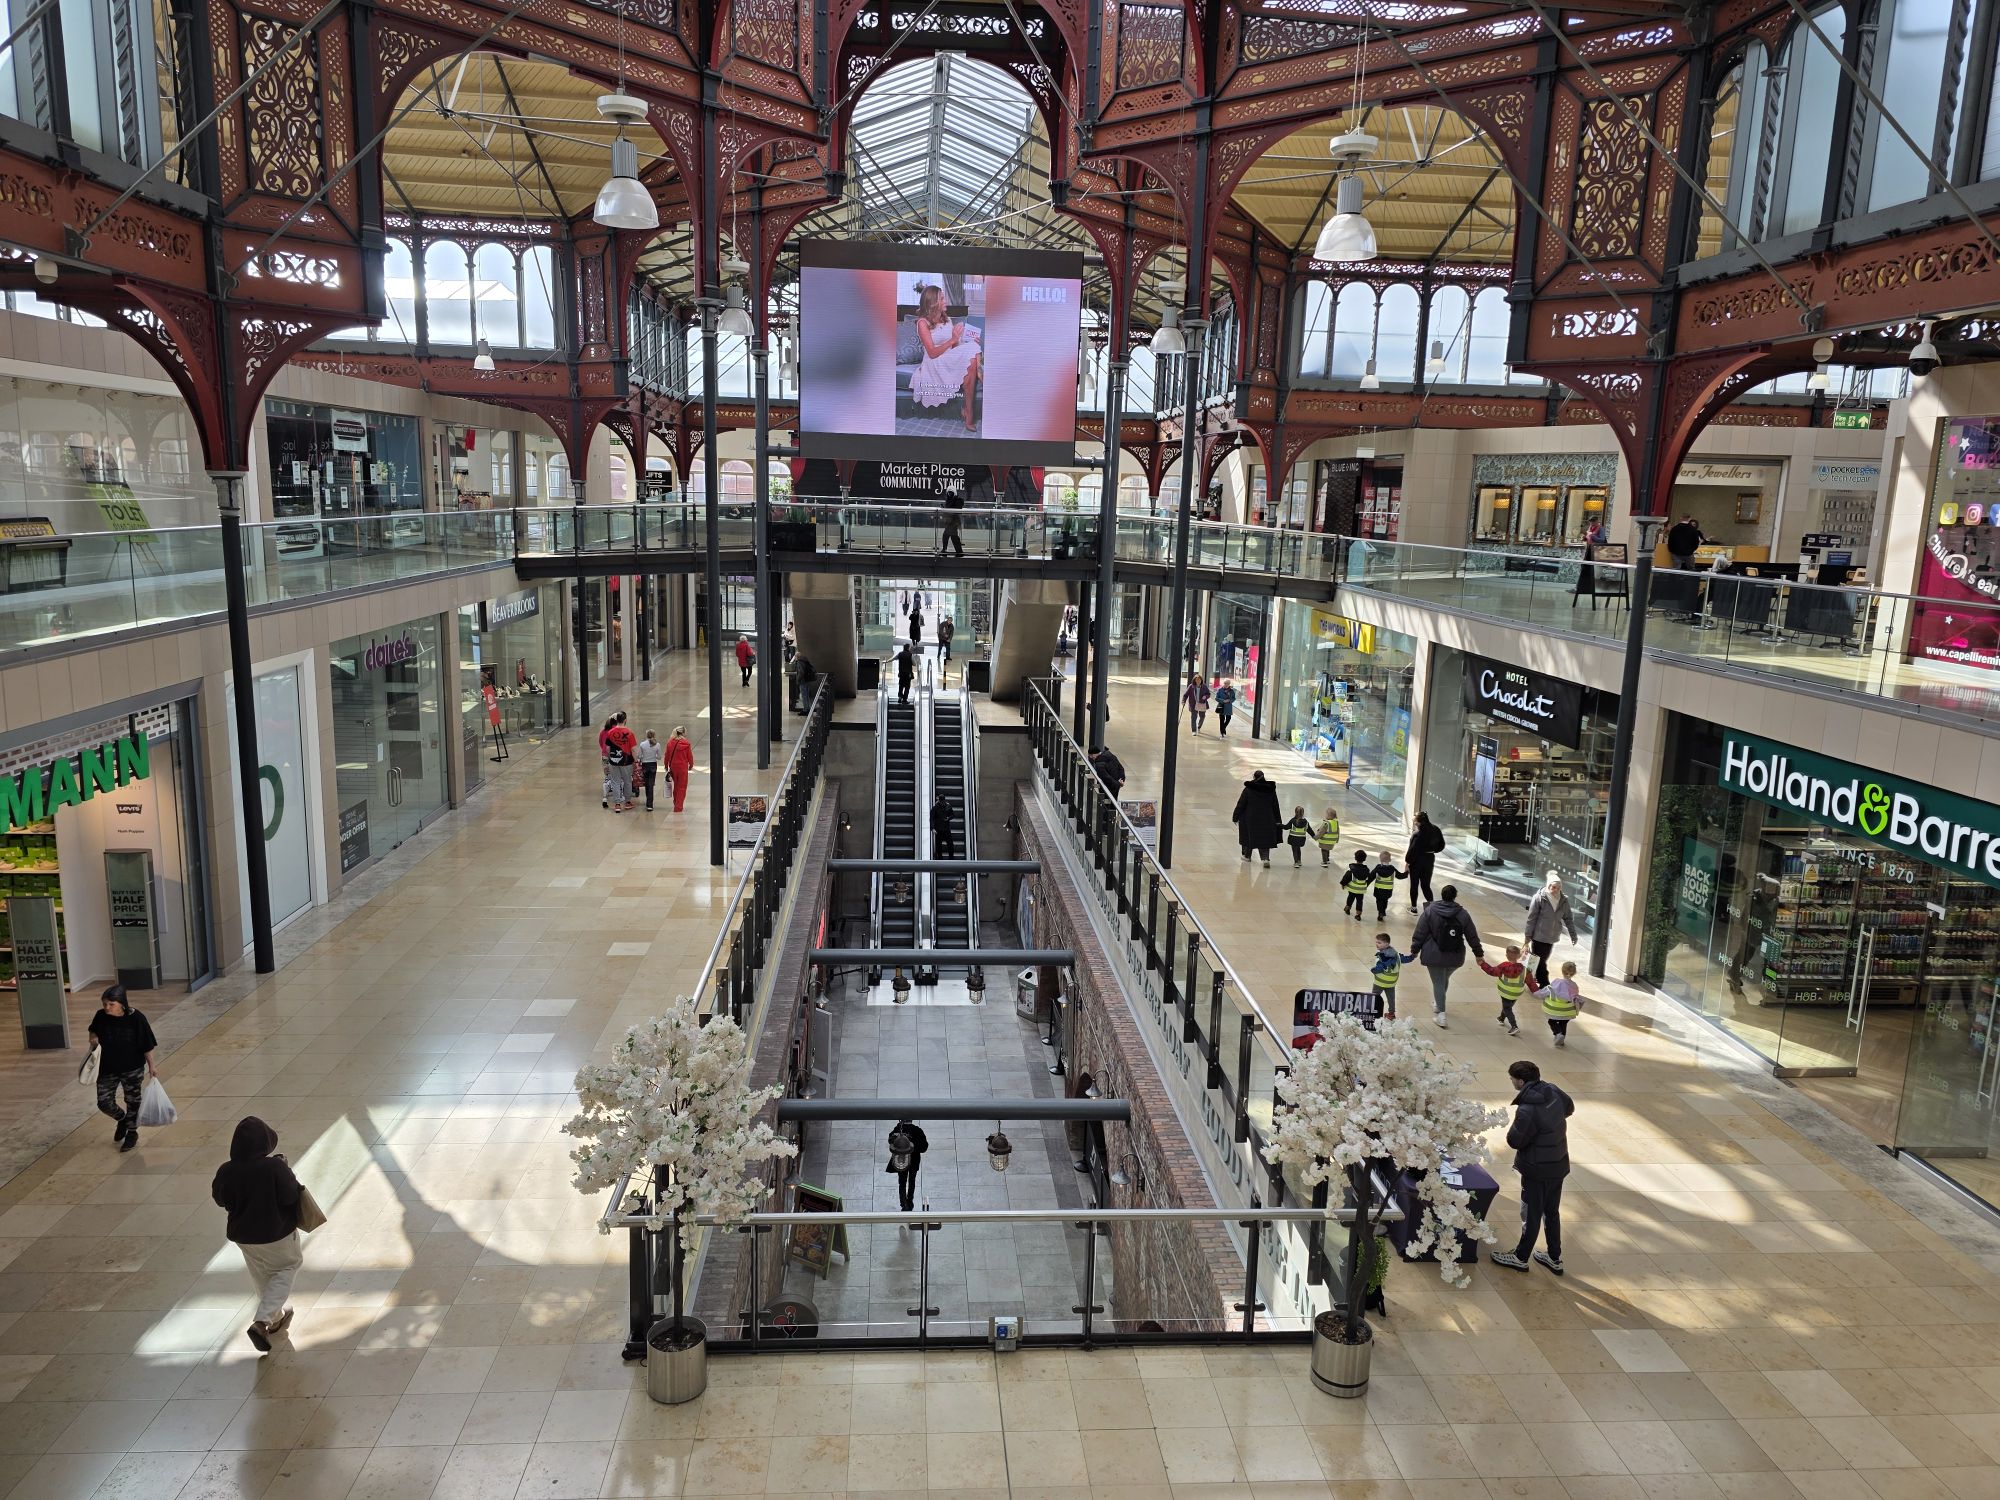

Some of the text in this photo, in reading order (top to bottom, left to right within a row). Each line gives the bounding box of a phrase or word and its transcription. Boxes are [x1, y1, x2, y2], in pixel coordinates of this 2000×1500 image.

[963, 282, 982, 291] HELLO!
[1022, 286, 1066, 304] HELLO!
[880, 463, 965, 478] Market Place
[1331, 462, 1360, 473] BLUE INC
[1698, 464, 1753, 480] Jewellers
[1830, 464, 1859, 476] pocket
[880, 476, 965, 495] COMMUNITY STAGE
[1831, 475, 1872, 485] tech repair
[101, 505, 145, 522] TO LET
[1928, 534, 1999, 595] Children's ear
[492, 595, 536, 623] BEAVERBROOKS
[1320, 619, 1345, 638] THE WORKS
[364, 630, 413, 671] claire's
[1505, 671, 1529, 686] HOTEL
[1507, 713, 1521, 725] COCOA
[0, 731, 151, 834] MANN
[353, 820, 367, 836] OFFER
[1833, 844, 1914, 885] SINCE 1870
[1684, 863, 1711, 886] BACK
[1684, 875, 1709, 898] YOUR
[113, 895, 145, 905] HALF
[1682, 887, 1708, 908] BODY
[114, 905, 146, 913] PRICE
[17, 945, 52, 955] HALF
[18, 955, 54, 964] PRICE
[1303, 991, 1378, 1014] PAINTBALL
